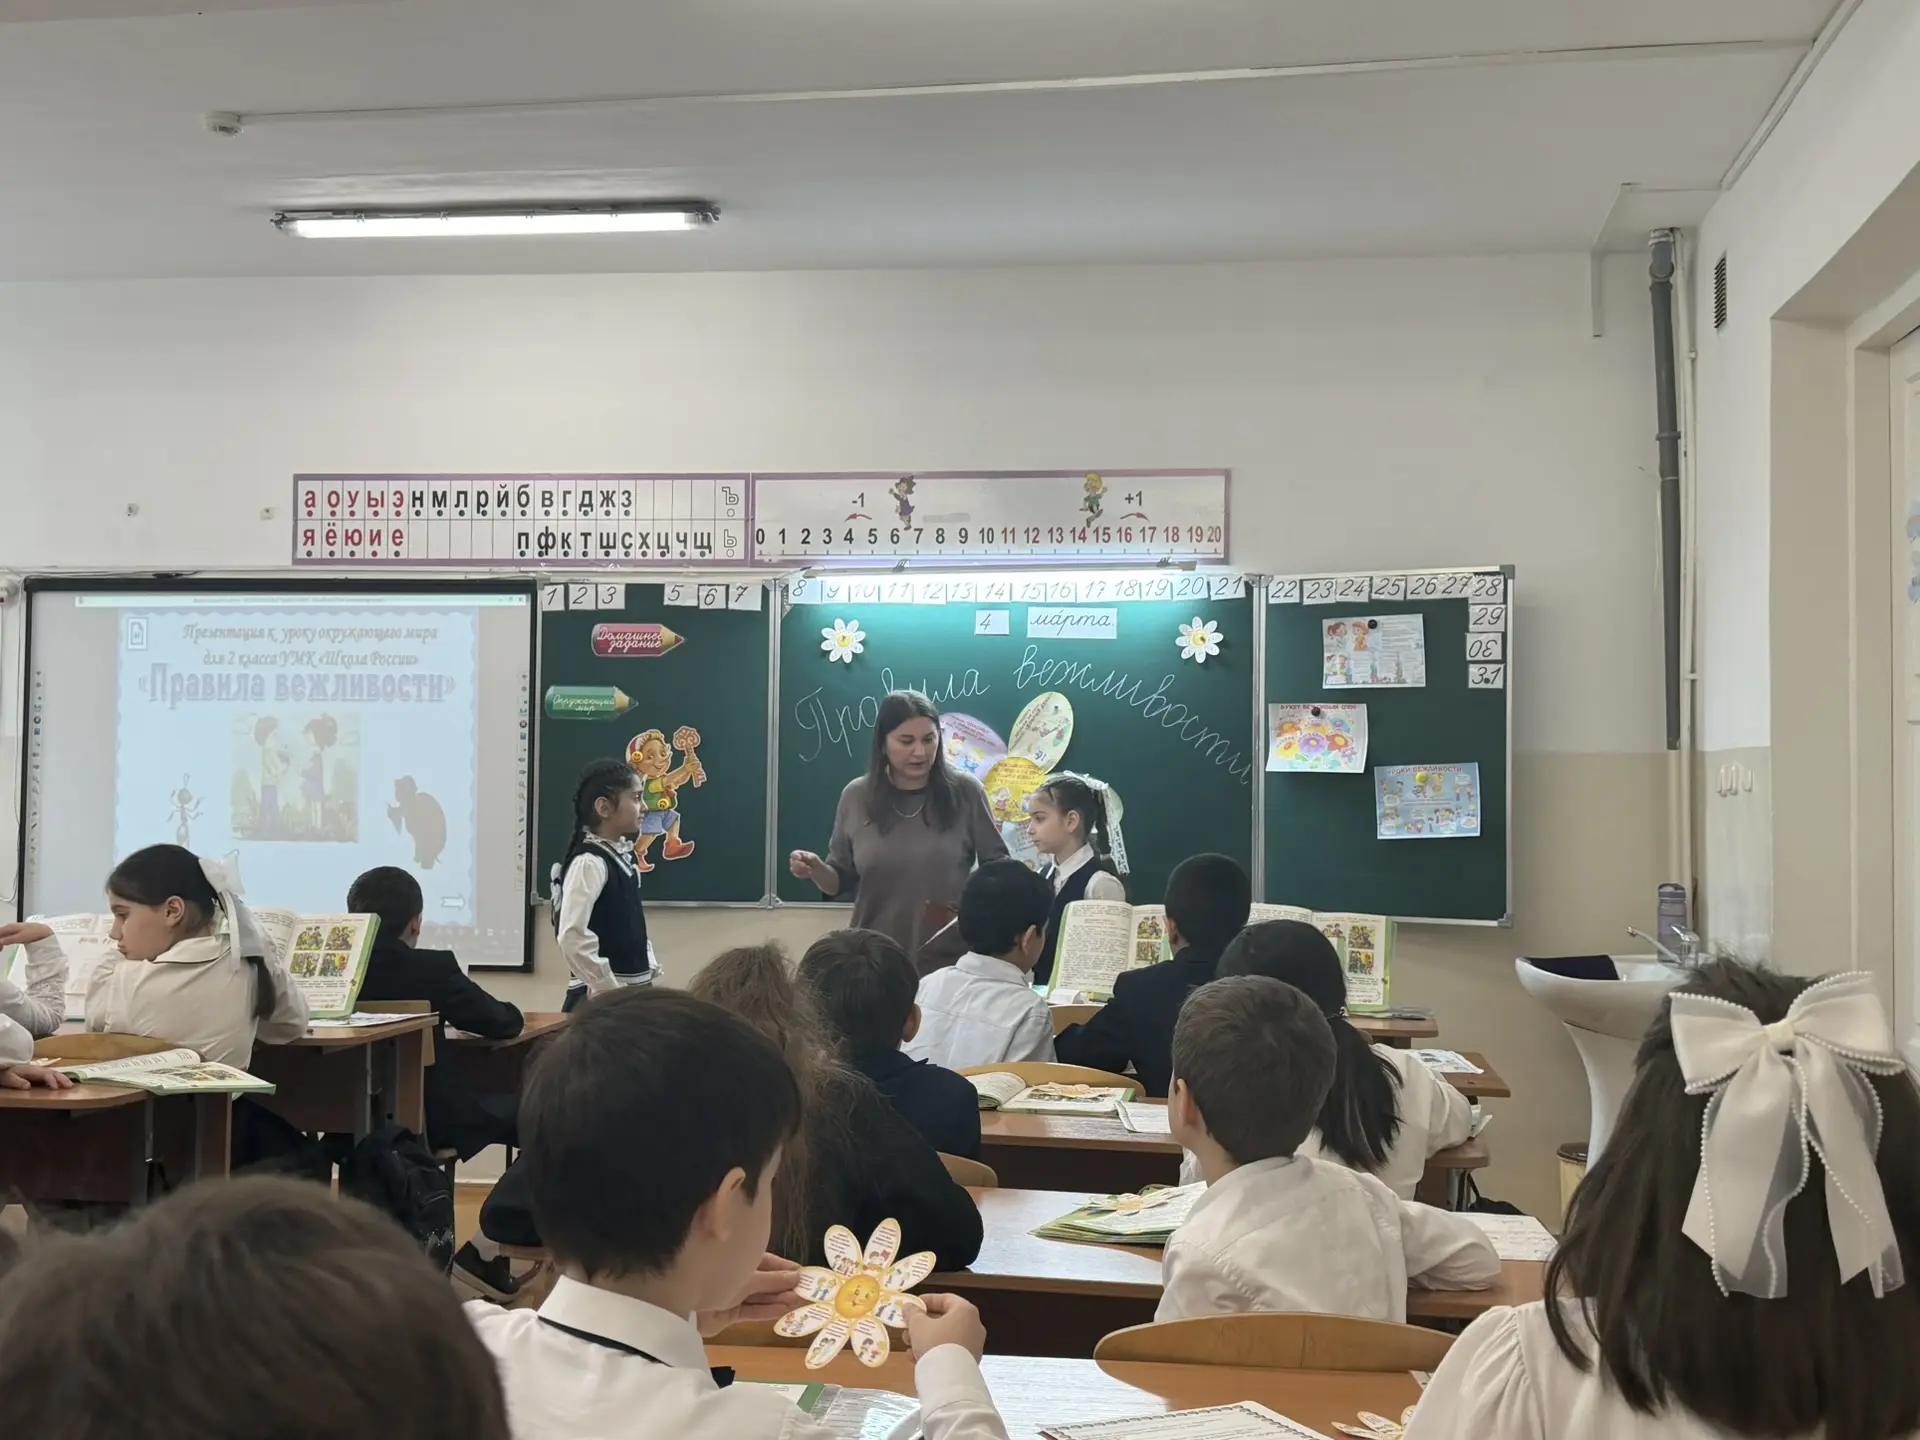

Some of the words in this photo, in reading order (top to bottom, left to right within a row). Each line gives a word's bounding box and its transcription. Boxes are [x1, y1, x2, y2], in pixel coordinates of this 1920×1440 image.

[852, 492, 864, 508] -1
[1124, 490, 1142, 506] +1
[756, 528, 765, 545] 0
[778, 528, 786, 544] 1
[800, 528, 810, 544] 2
[822, 528, 832, 544] 3
[844, 527, 854, 544] 4
[868, 527, 878, 544] 5
[890, 527, 900, 544] 6
[914, 527, 924, 544] 7
[936, 527, 945, 544] 8
[958, 527, 968, 544] 9
[979, 527, 994, 544] 10
[1001, 527, 1016, 544] 11
[1024, 527, 1040, 543] 12
[1048, 527, 1064, 543] 13
[1070, 526, 1087, 543] 14
[1092, 526, 1111, 543] 15
[1116, 526, 1132, 543] 16
[1140, 526, 1157, 543] 17
[1163, 526, 1180, 543] 18
[1187, 526, 1204, 543] 19
[1207, 526, 1222, 543] 20
[546, 588, 557, 604] 1
[572, 586, 588, 604] 2
[602, 586, 617, 604] 3
[668, 584, 684, 602] 5
[704, 588, 718, 605] 6
[734, 586, 748, 602] 7
[792, 579, 807, 597] 8
[826, 584, 840, 598] 9
[854, 584, 877, 599] 10
[888, 582, 914, 598] 11
[922, 583, 942, 600] 12
[951, 583, 972, 599] 13
[984, 583, 1006, 599] 14
[1020, 582, 1042, 600] 15
[1050, 582, 1072, 598] 16
[1085, 581, 1108, 598] 17
[1114, 579, 1138, 597] 18
[1144, 578, 1169, 597] 19
[1176, 576, 1204, 596] 20
[1214, 576, 1244, 594] 21
[1270, 580, 1298, 598] 22
[1306, 580, 1333, 600] 23
[1339, 579, 1366, 597] 24
[1374, 577, 1401, 596] 25
[1410, 576, 1438, 596] 26
[1442, 576, 1472, 594] 27
[1472, 578, 1502, 597] 28
[978, 612, 992, 630] 4
[1472, 606, 1505, 626] 29
[182, 624, 266, 644] Презентация
[267, 629, 278, 644] к
[281, 627, 318, 645] уроку
[318, 626, 402, 645] окружающего
[403, 627, 438, 644] мира
[608, 640, 662, 653] задание
[203, 651, 226, 666] для
[228, 652, 236, 666] 2
[237, 653, 278, 667] класса
[279, 650, 318, 668] УМК
[1471, 666, 1502, 686] 31
[1013, 645, 1252, 785] вежливости
